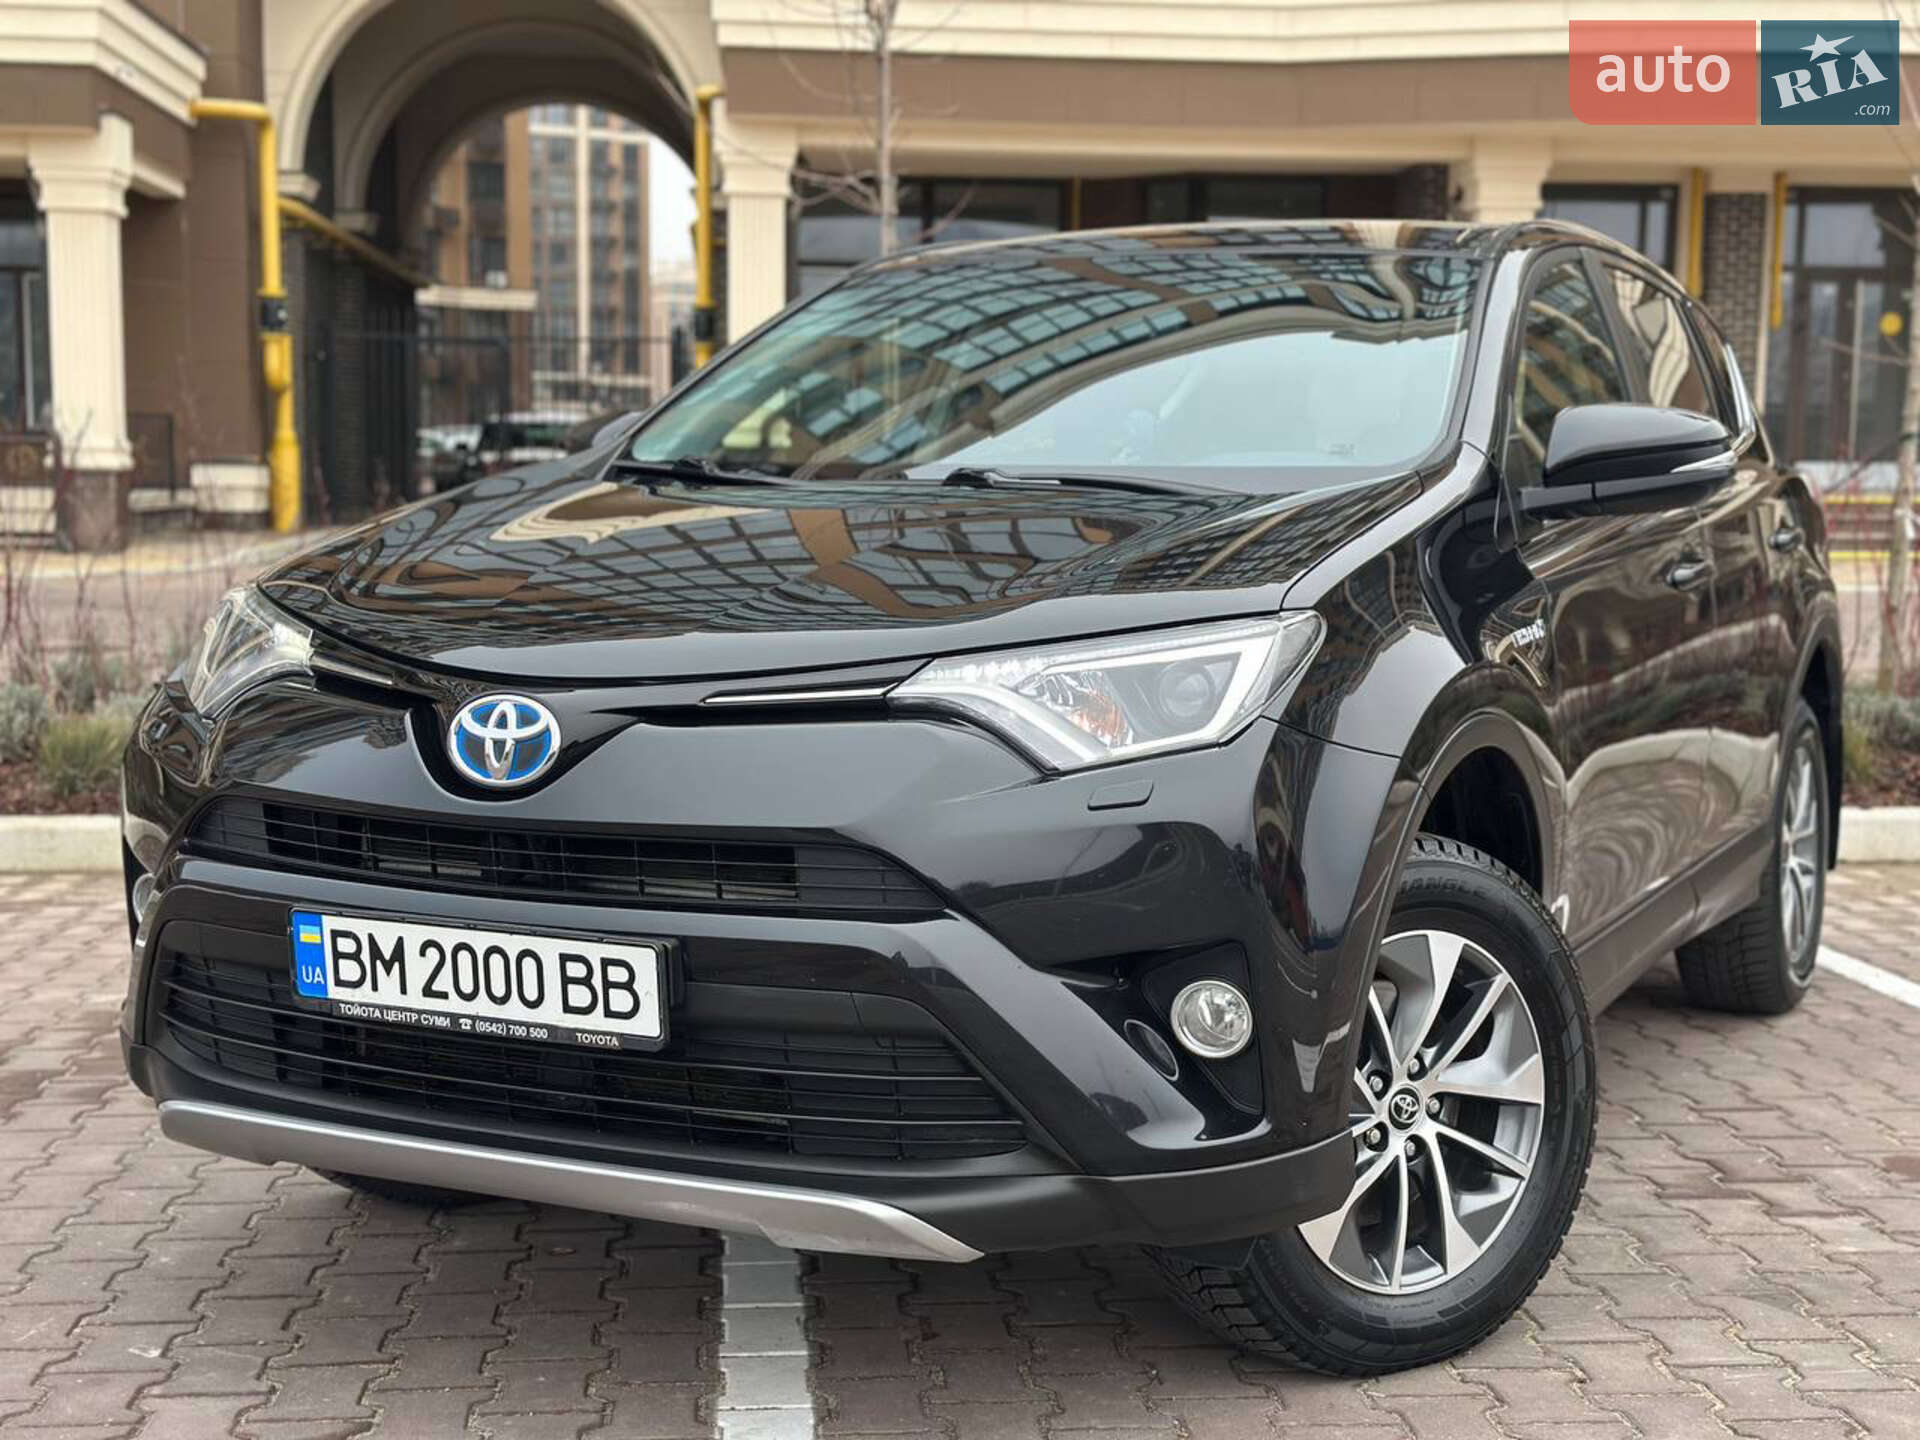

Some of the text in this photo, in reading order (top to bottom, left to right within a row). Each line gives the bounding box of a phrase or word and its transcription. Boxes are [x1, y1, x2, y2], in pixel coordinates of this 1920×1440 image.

[302, 965, 325, 984] UA
[330, 929, 641, 1019] BM 2000 BB
[339, 1003, 548, 1039] ТОЙОТА ЦЕНТР СУМИ (0542) 700 500
[576, 1032, 619, 1046] TOYOTA
